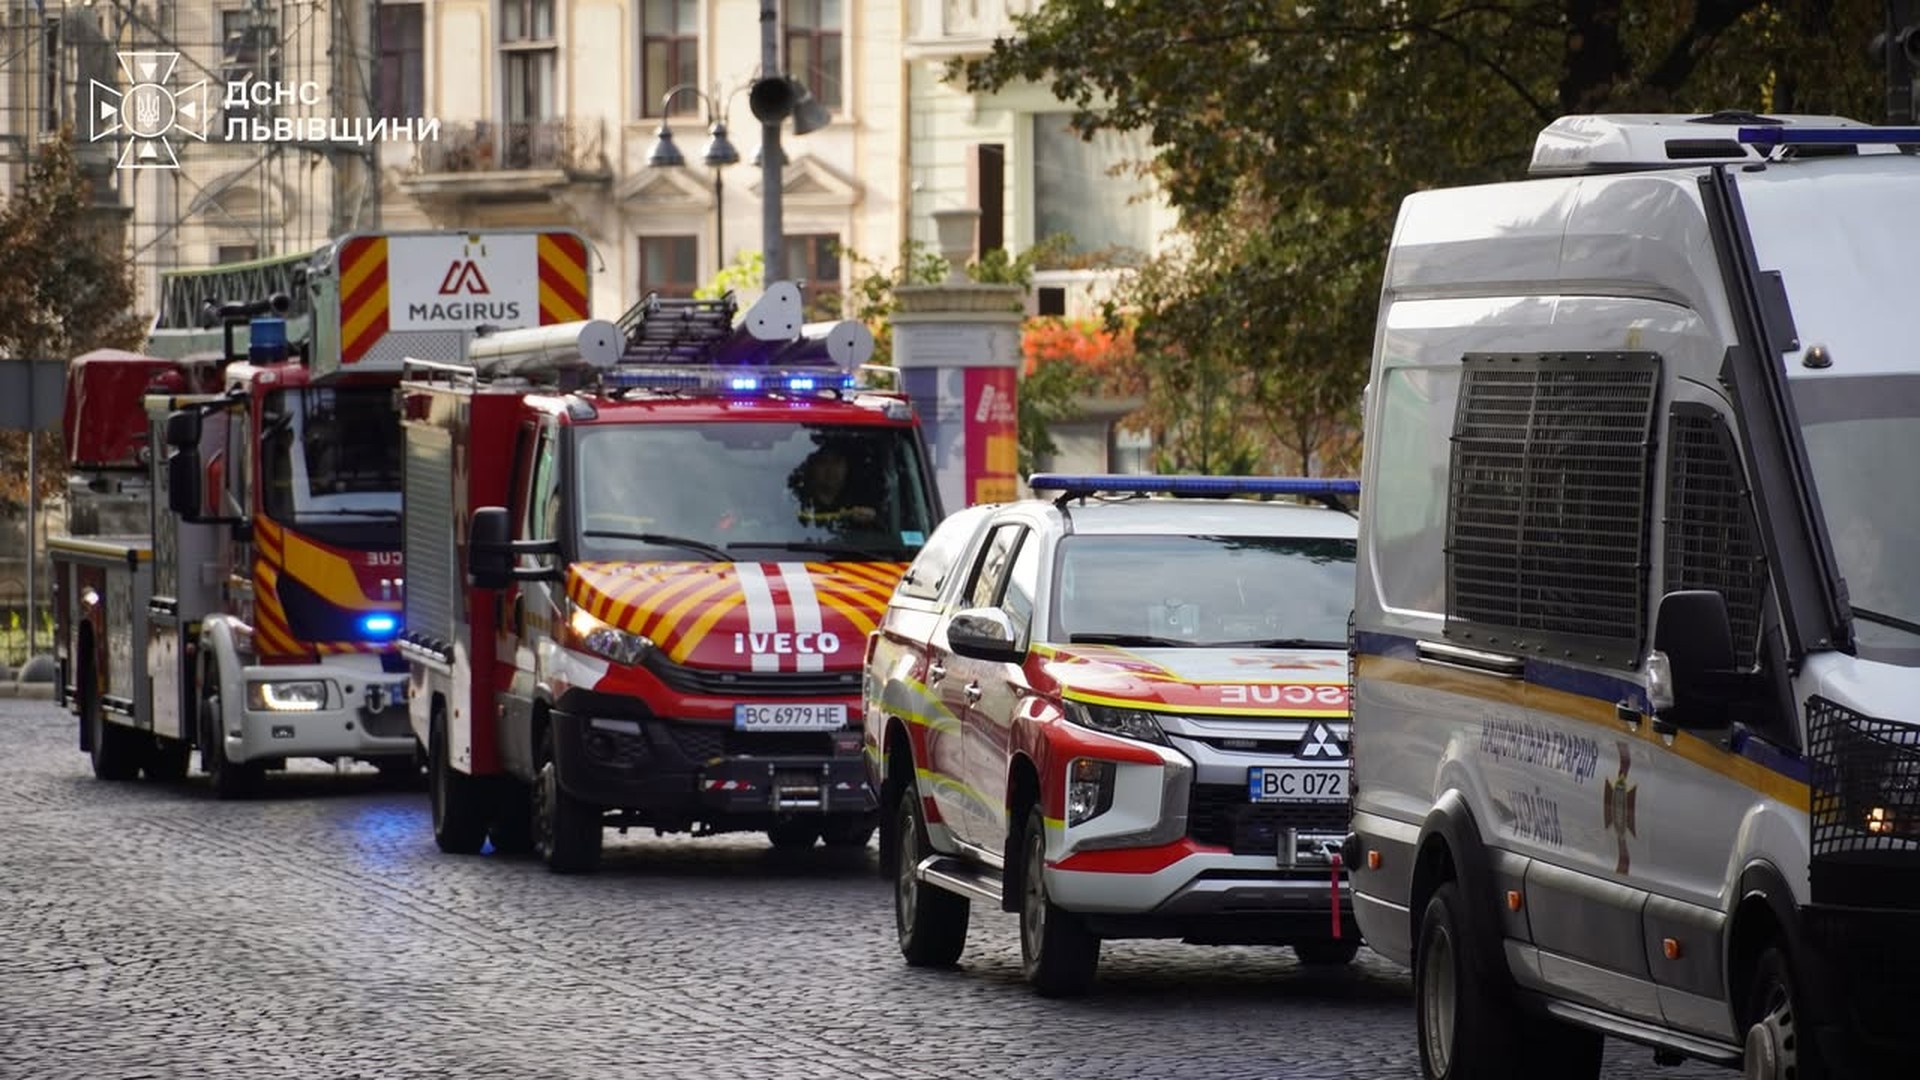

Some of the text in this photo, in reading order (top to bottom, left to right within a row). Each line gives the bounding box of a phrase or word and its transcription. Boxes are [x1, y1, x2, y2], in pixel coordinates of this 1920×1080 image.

[408, 302, 520, 321] MAGIRUS
[734, 632, 840, 654] IVECO
[745, 707, 841, 724] BC 6979 HE
[1264, 773, 1295, 795] BC
